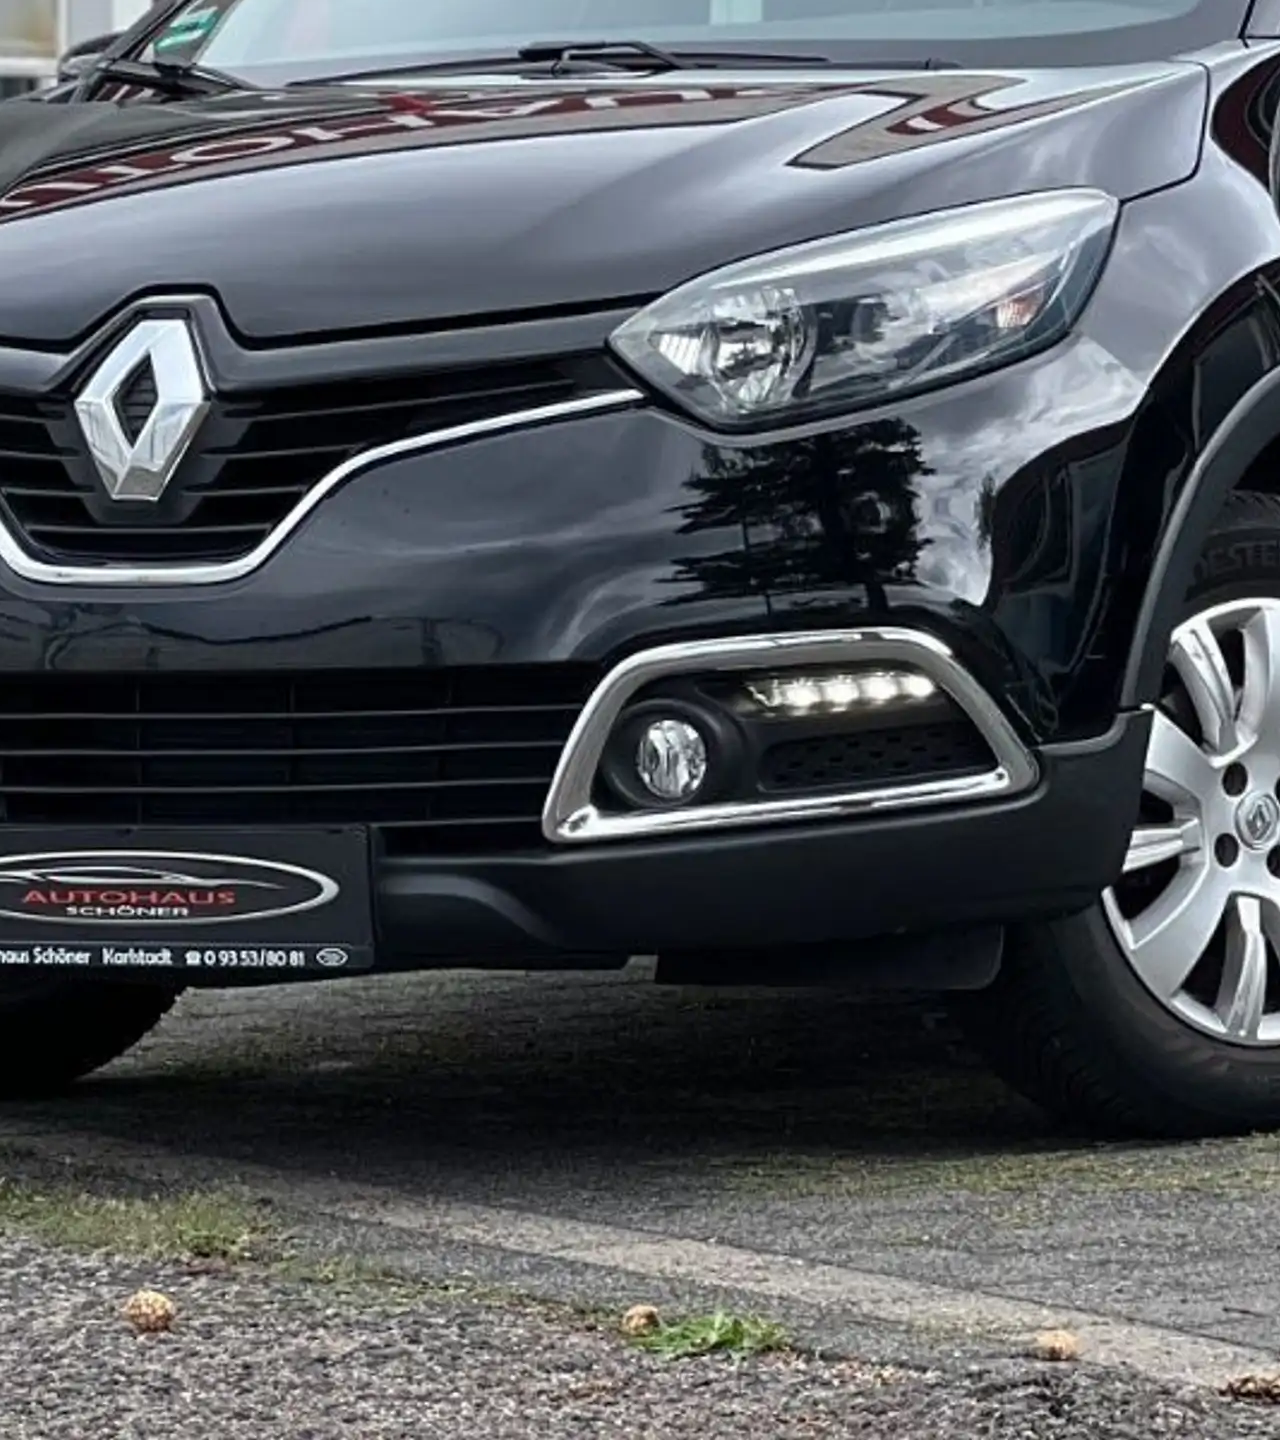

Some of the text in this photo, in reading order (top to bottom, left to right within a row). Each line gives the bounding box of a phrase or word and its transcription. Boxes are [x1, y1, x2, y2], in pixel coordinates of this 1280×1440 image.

[23, 889, 236, 905] AUTOHAUS
[65, 904, 190, 917] SCHÖNER
[33, 945, 92, 965] Schöner
